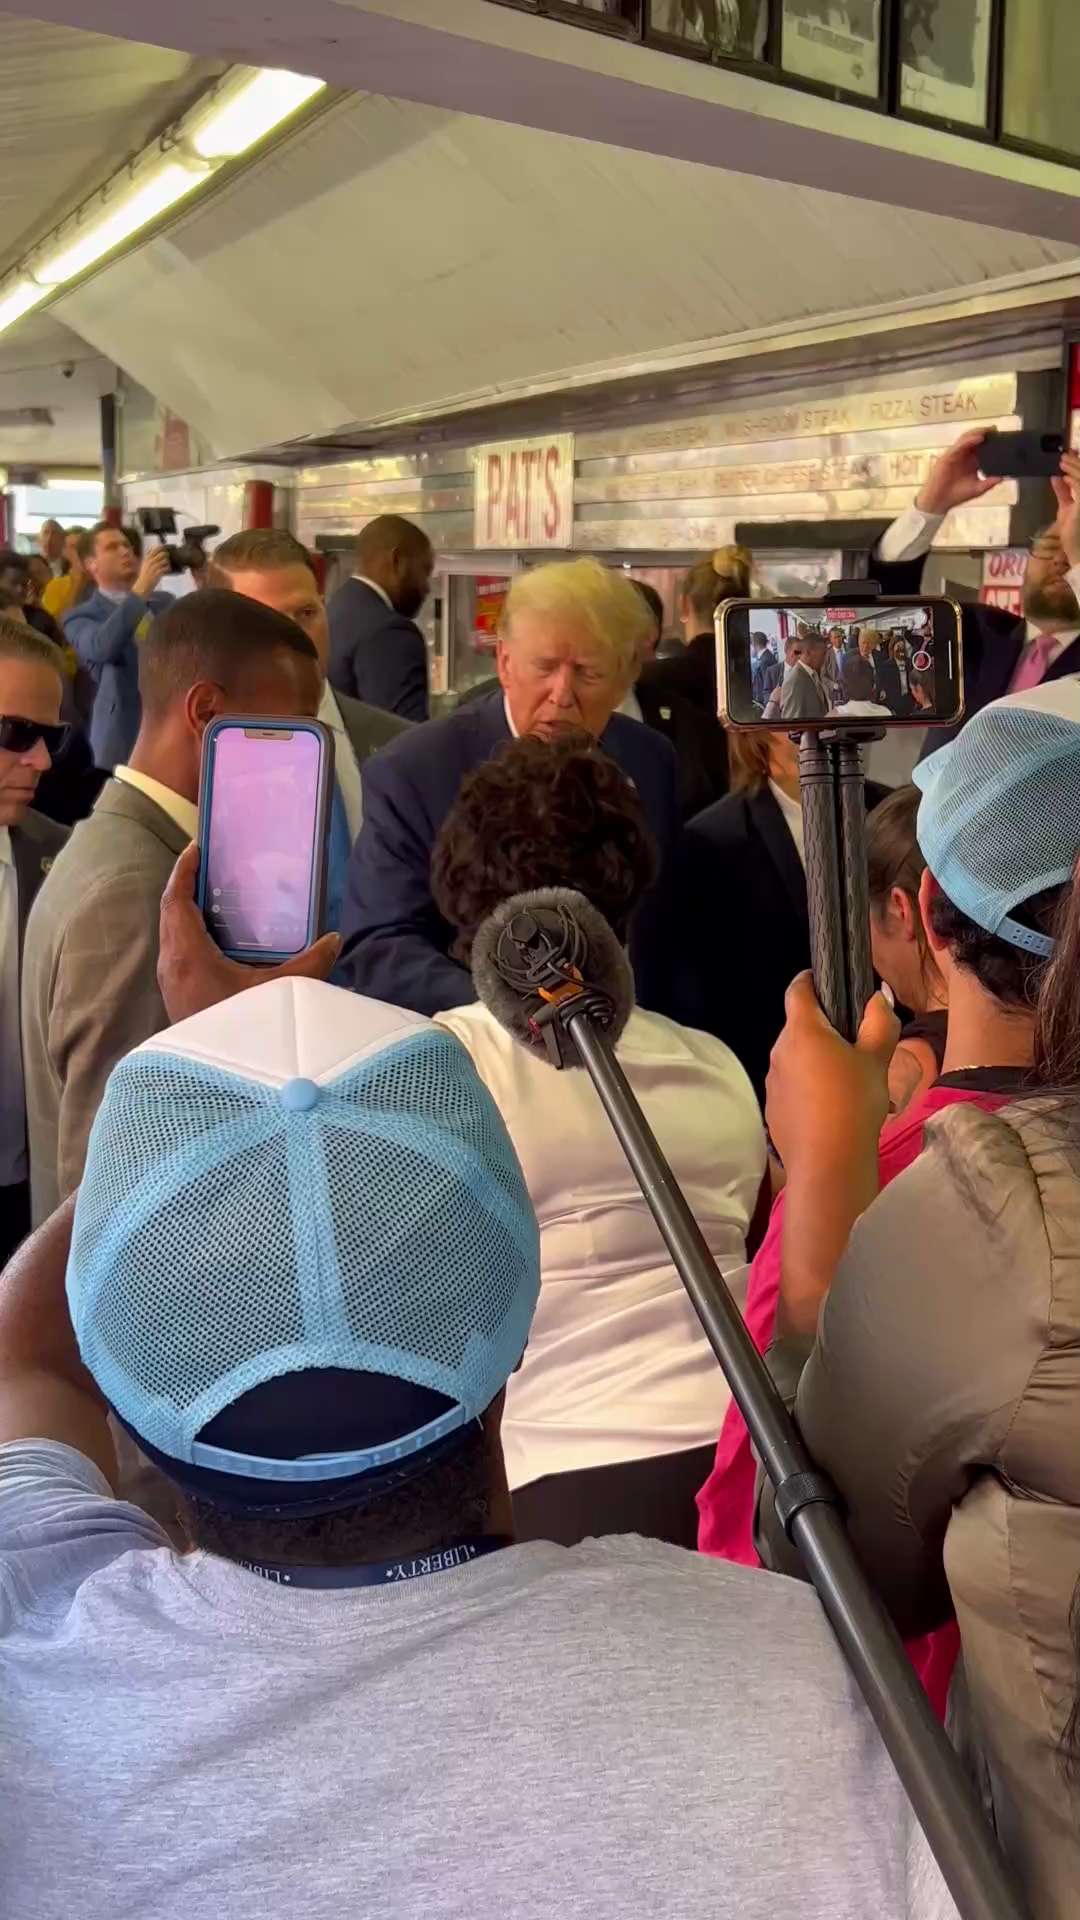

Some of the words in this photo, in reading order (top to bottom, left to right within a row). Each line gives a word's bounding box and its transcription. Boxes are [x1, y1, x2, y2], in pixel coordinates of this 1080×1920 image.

[919, 391, 979, 418] STEAK
[486, 445, 560, 540] PAT'S
[394, 1544, 470, 1581] LIBERTY
